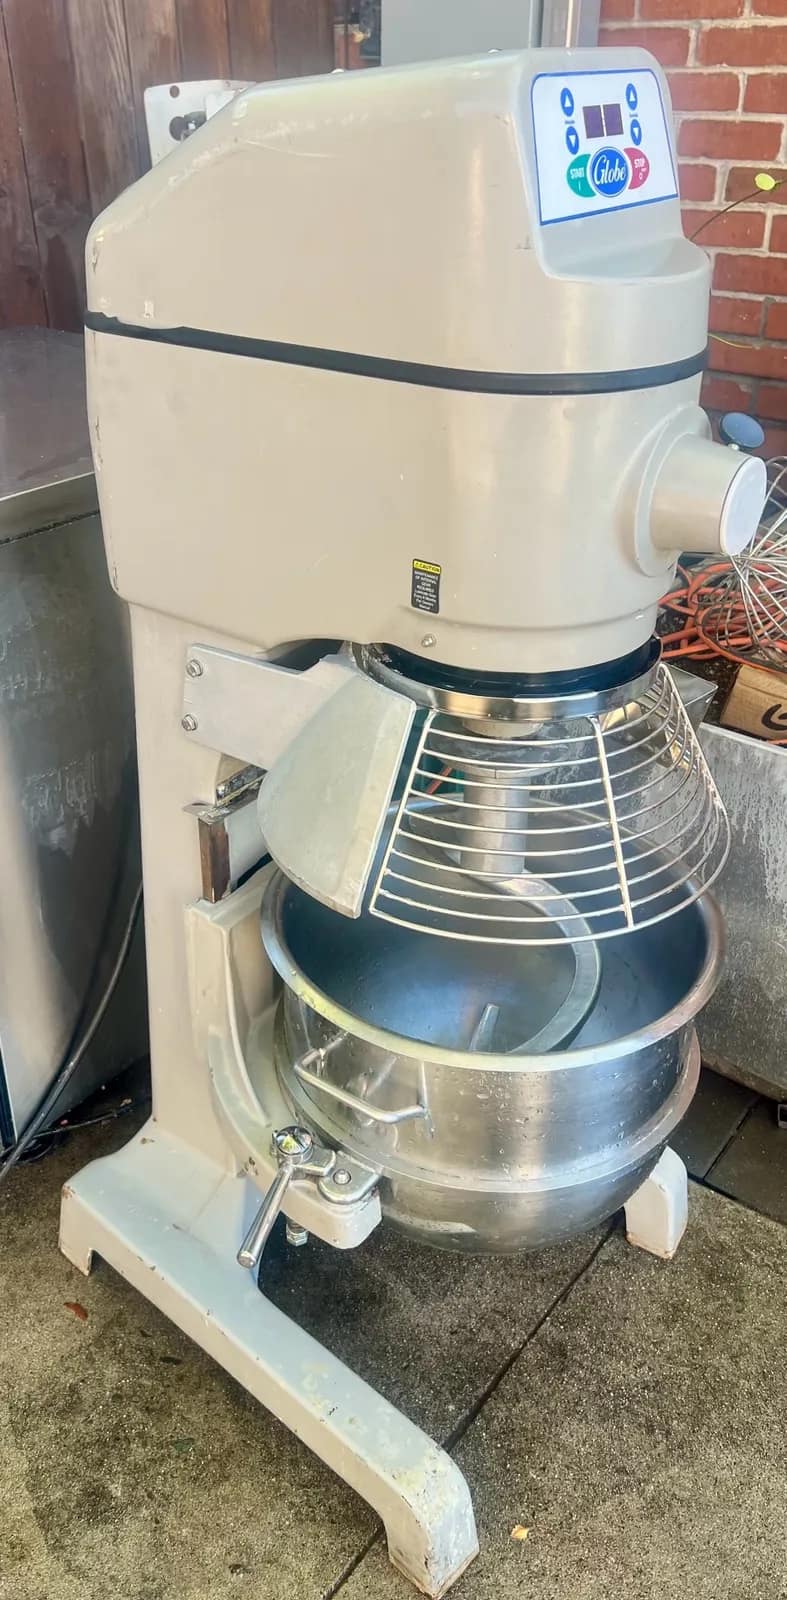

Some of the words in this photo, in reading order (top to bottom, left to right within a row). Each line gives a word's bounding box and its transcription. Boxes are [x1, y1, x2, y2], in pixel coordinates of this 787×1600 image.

[634, 158, 645, 168] STOP
[570, 167, 584, 179] START
[593, 154, 626, 185] Globe
[419, 563, 440, 572] CAUTION
